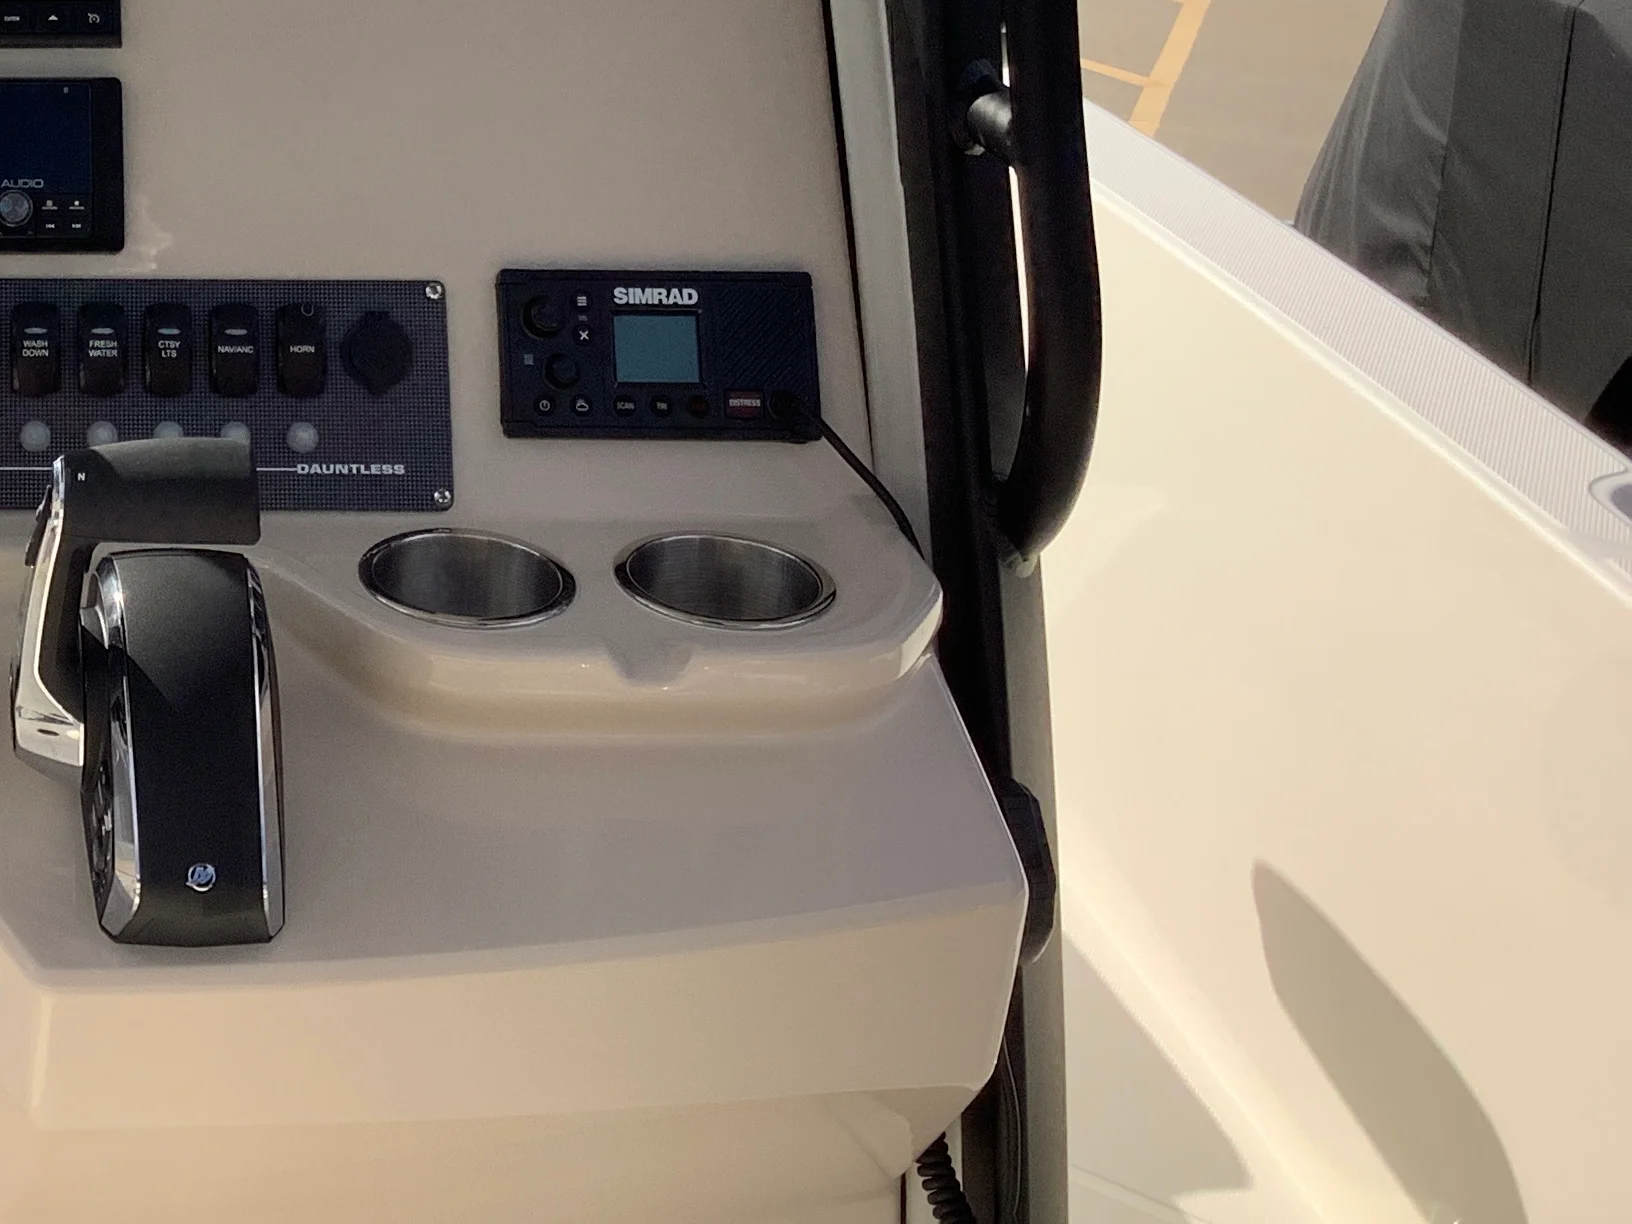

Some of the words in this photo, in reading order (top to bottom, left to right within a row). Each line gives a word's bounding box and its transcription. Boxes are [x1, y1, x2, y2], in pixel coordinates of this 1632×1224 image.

[1, 179, 45, 188] AUDIO
[613, 287, 699, 305] SIMRAD
[23, 340, 49, 348] WASH
[89, 340, 118, 348] FRESH
[157, 340, 181, 349] CTSY
[22, 349, 49, 357] DOWN
[88, 349, 118, 357] WATER
[161, 350, 177, 358] LTS
[290, 345, 315, 354] HORN
[617, 402, 635, 410] SCAN
[728, 398, 761, 408] DISTRESS
[296, 463, 405, 475] DAUNTLESS
[78, 472, 86, 481] N
